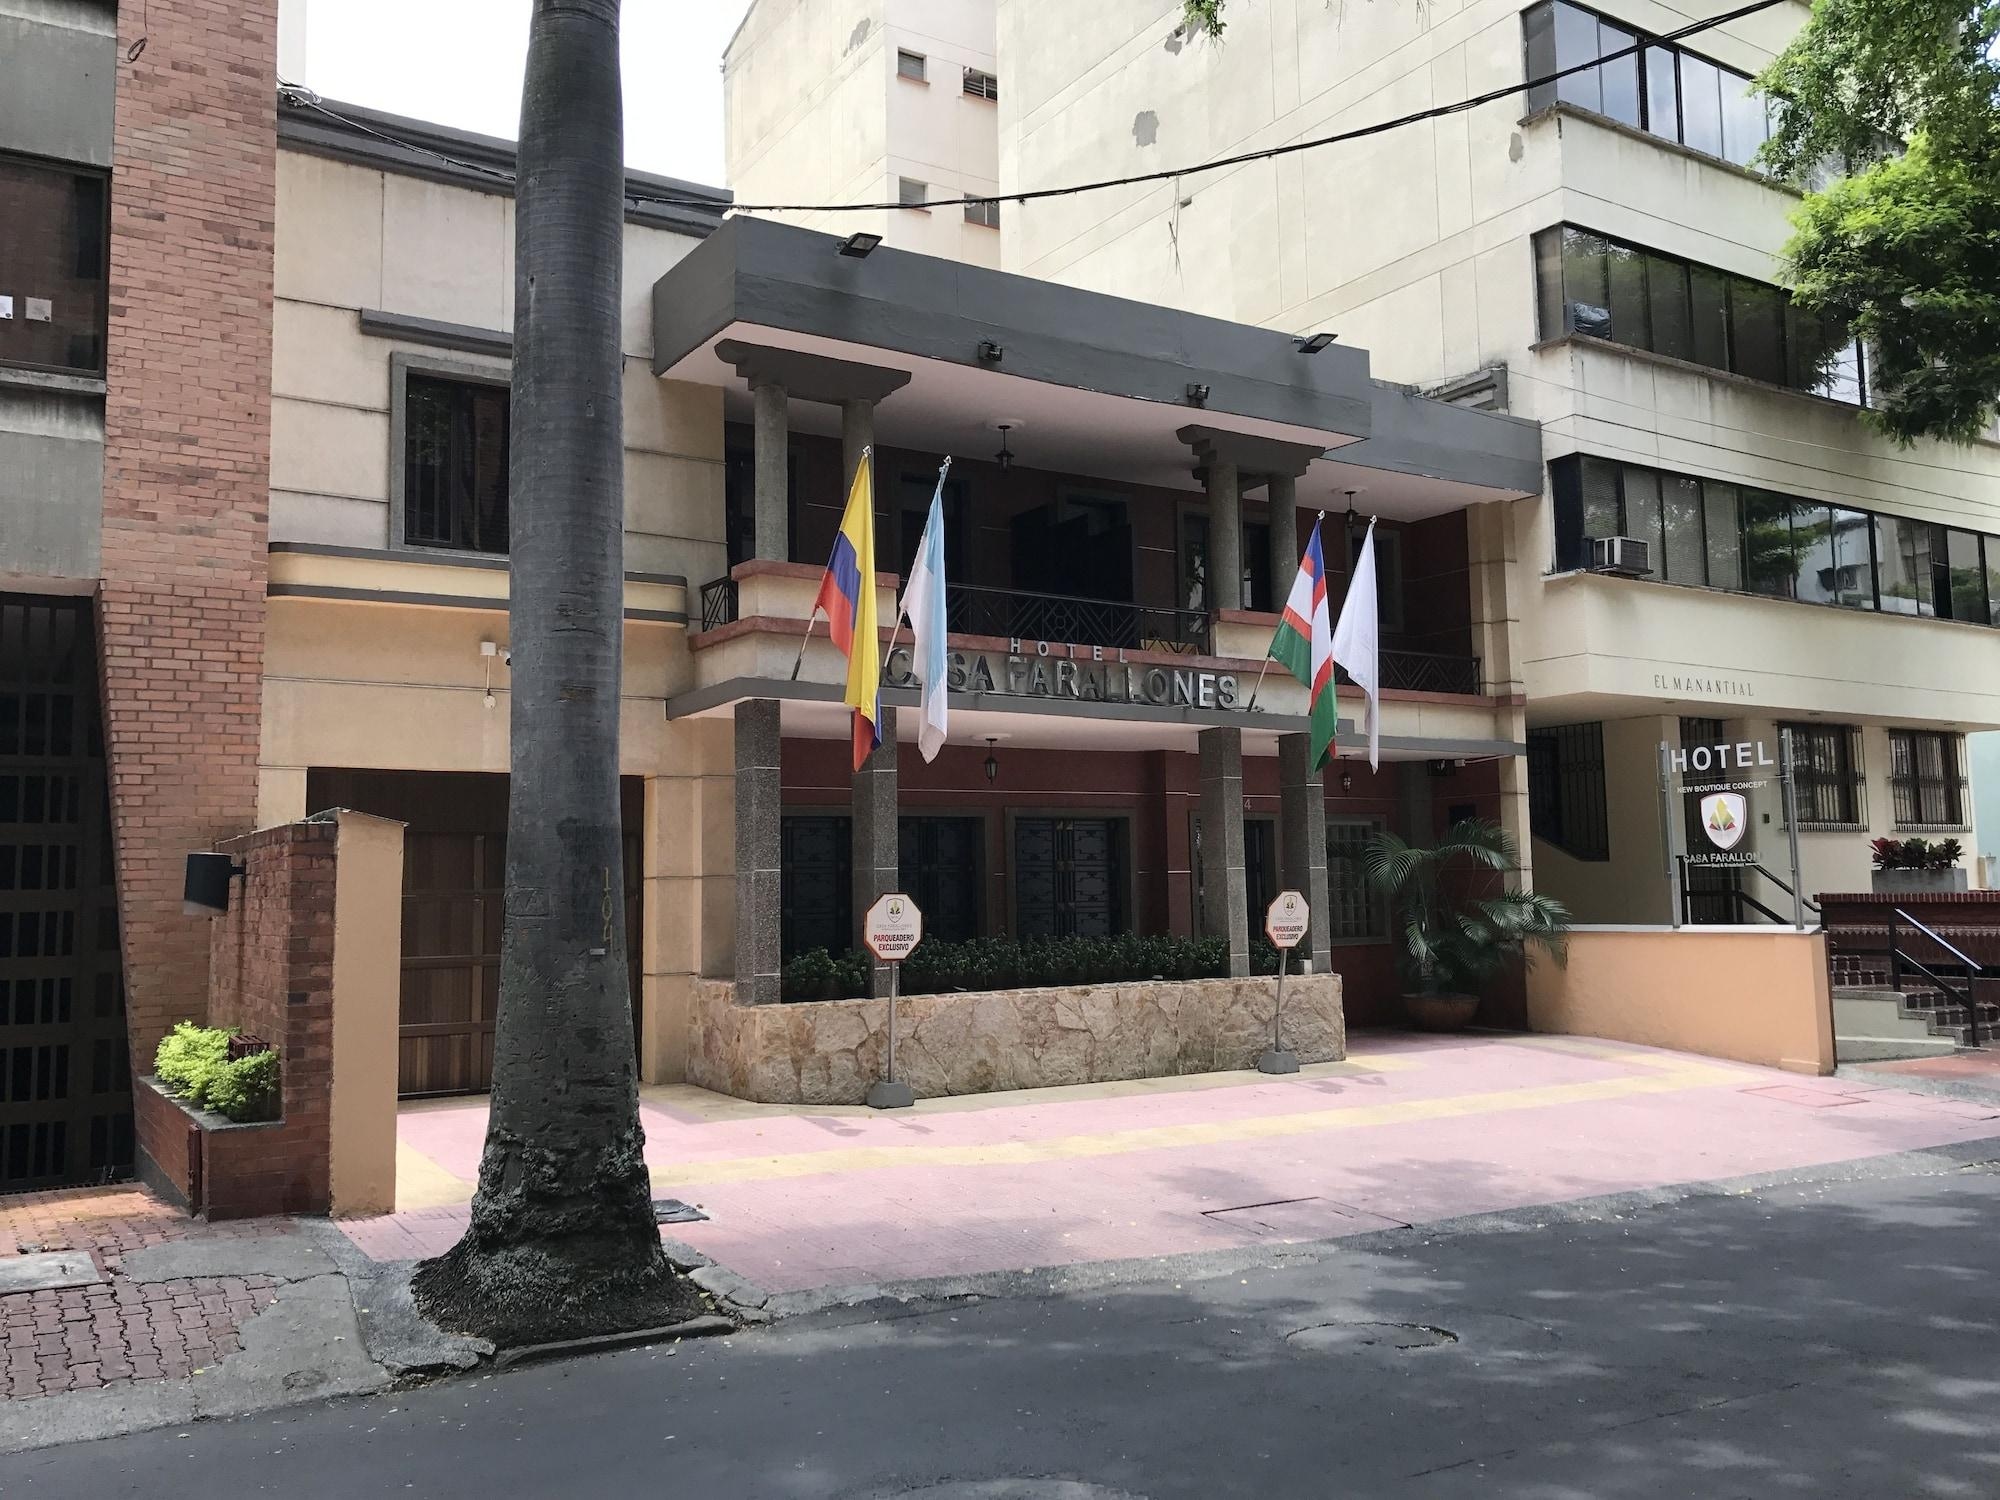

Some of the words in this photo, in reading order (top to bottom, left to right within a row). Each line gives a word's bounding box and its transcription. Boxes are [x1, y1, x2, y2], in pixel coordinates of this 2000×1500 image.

[1010, 637, 1129, 663] HOTEL
[884, 647, 995, 691] CSA
[1008, 656, 1238, 709] FARALLONES
[1654, 674, 1668, 689] EL
[1673, 676, 1754, 697] MANANTIAL
[1671, 741, 1774, 773] HOTEL
[1677, 785, 1693, 793] NEW
[1694, 783, 1731, 792] BOUTIQUE
[1732, 780, 1768, 790] CONCEPT
[1683, 854, 1708, 863] CASA
[873, 934, 914, 942] PARQUEADERO
[878, 943, 909, 951] EXCLUSIVO
